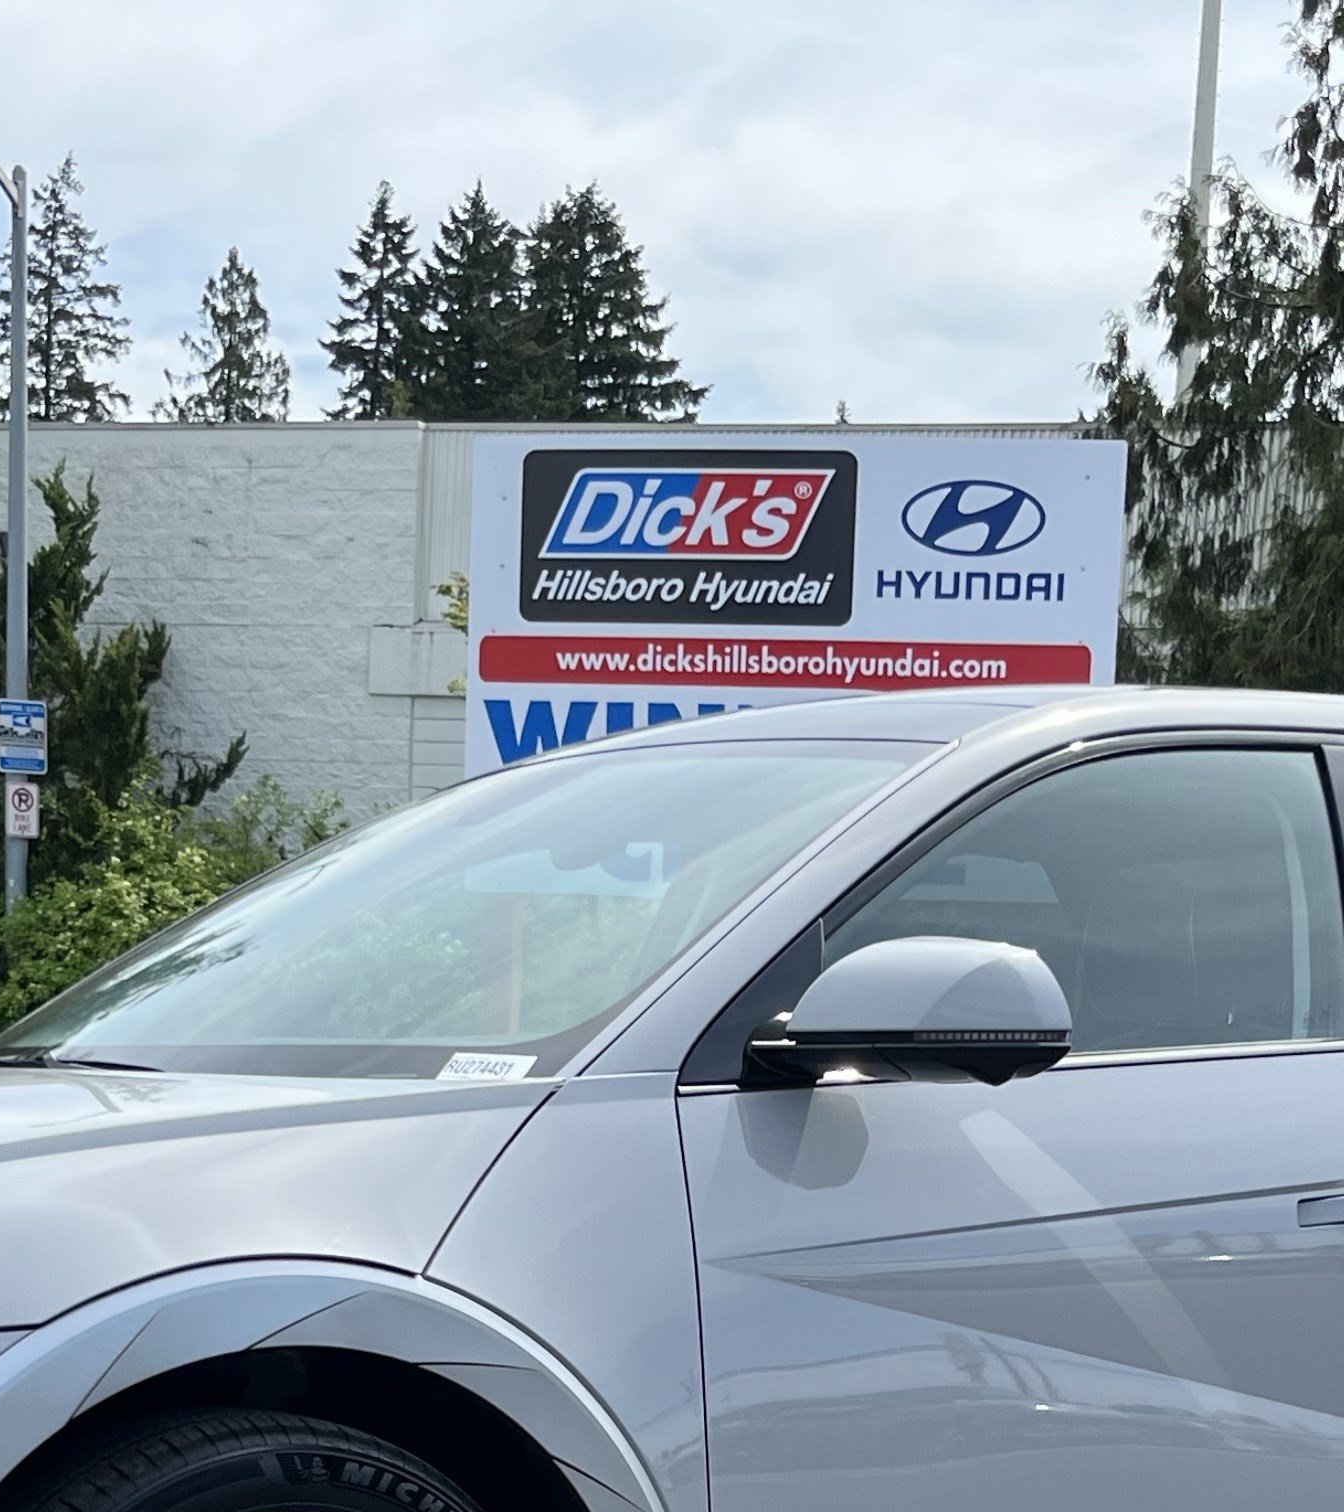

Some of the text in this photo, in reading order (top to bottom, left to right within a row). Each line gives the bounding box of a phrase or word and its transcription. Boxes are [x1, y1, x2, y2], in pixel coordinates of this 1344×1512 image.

[561, 479, 797, 548] Dick's
[532, 569, 834, 611] Hillsboro Hyundai
[876, 570, 1064, 602] HYUNDAI
[556, 644, 1007, 682] www.dickshillsborohyundai.com
